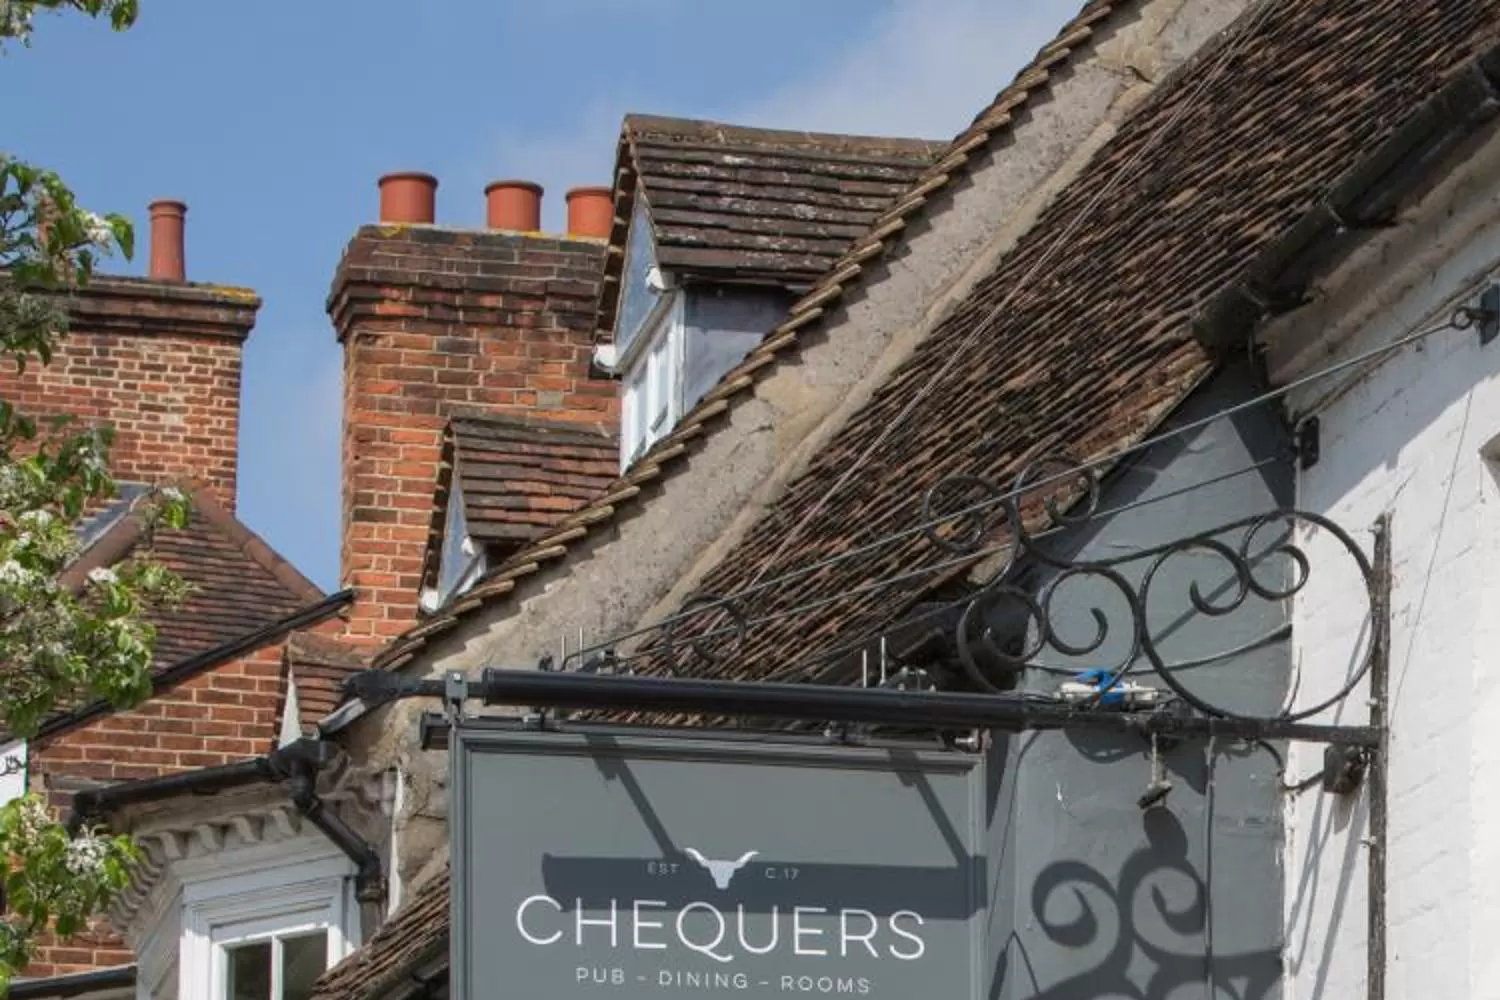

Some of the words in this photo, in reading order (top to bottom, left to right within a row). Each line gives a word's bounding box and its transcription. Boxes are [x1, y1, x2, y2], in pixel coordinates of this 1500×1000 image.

[516, 895, 926, 962] CHEQUERS
[576, 967, 625, 985] PUB
[658, 970, 748, 990] DINING
[781, 975, 871, 994] ROOMS
